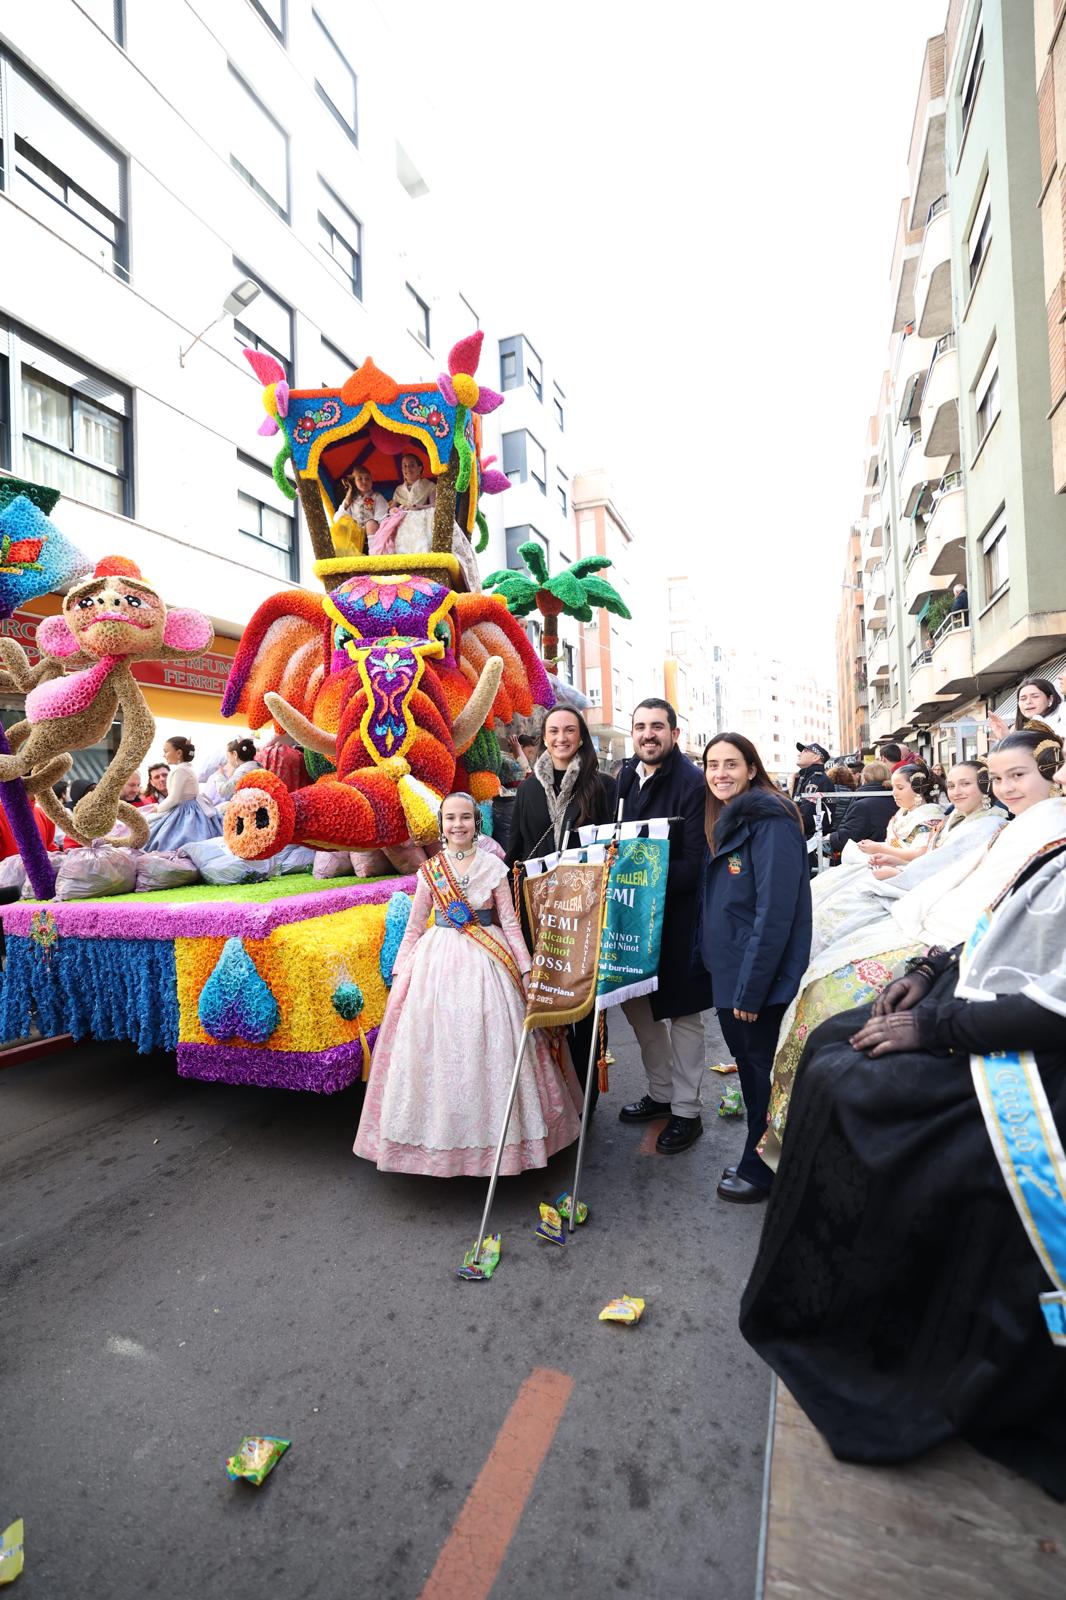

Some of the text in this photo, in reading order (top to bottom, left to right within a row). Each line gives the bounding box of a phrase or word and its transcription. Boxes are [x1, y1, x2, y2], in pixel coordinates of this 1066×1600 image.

[164, 669, 228, 692] FERRET
[616, 869, 648, 887] FALLERA
[554, 894, 583, 913] FALLERA
[605, 887, 636, 909] EMI
[540, 913, 579, 932] REMI
[540, 931, 575, 945] alcada
[608, 931, 640, 943] NINOT
[541, 941, 571, 957] Ninot
[580, 920, 592, 976] INFANTILS
[604, 940, 616, 950] del
[617, 942, 640, 952] Ninot
[535, 954, 572, 973] OSSA
[600, 952, 617, 961] LES
[531, 970, 550, 981] LES
[608, 963, 644, 974] burriana
[540, 982, 575, 997] burriana
[536, 994, 554, 1005] 2025
